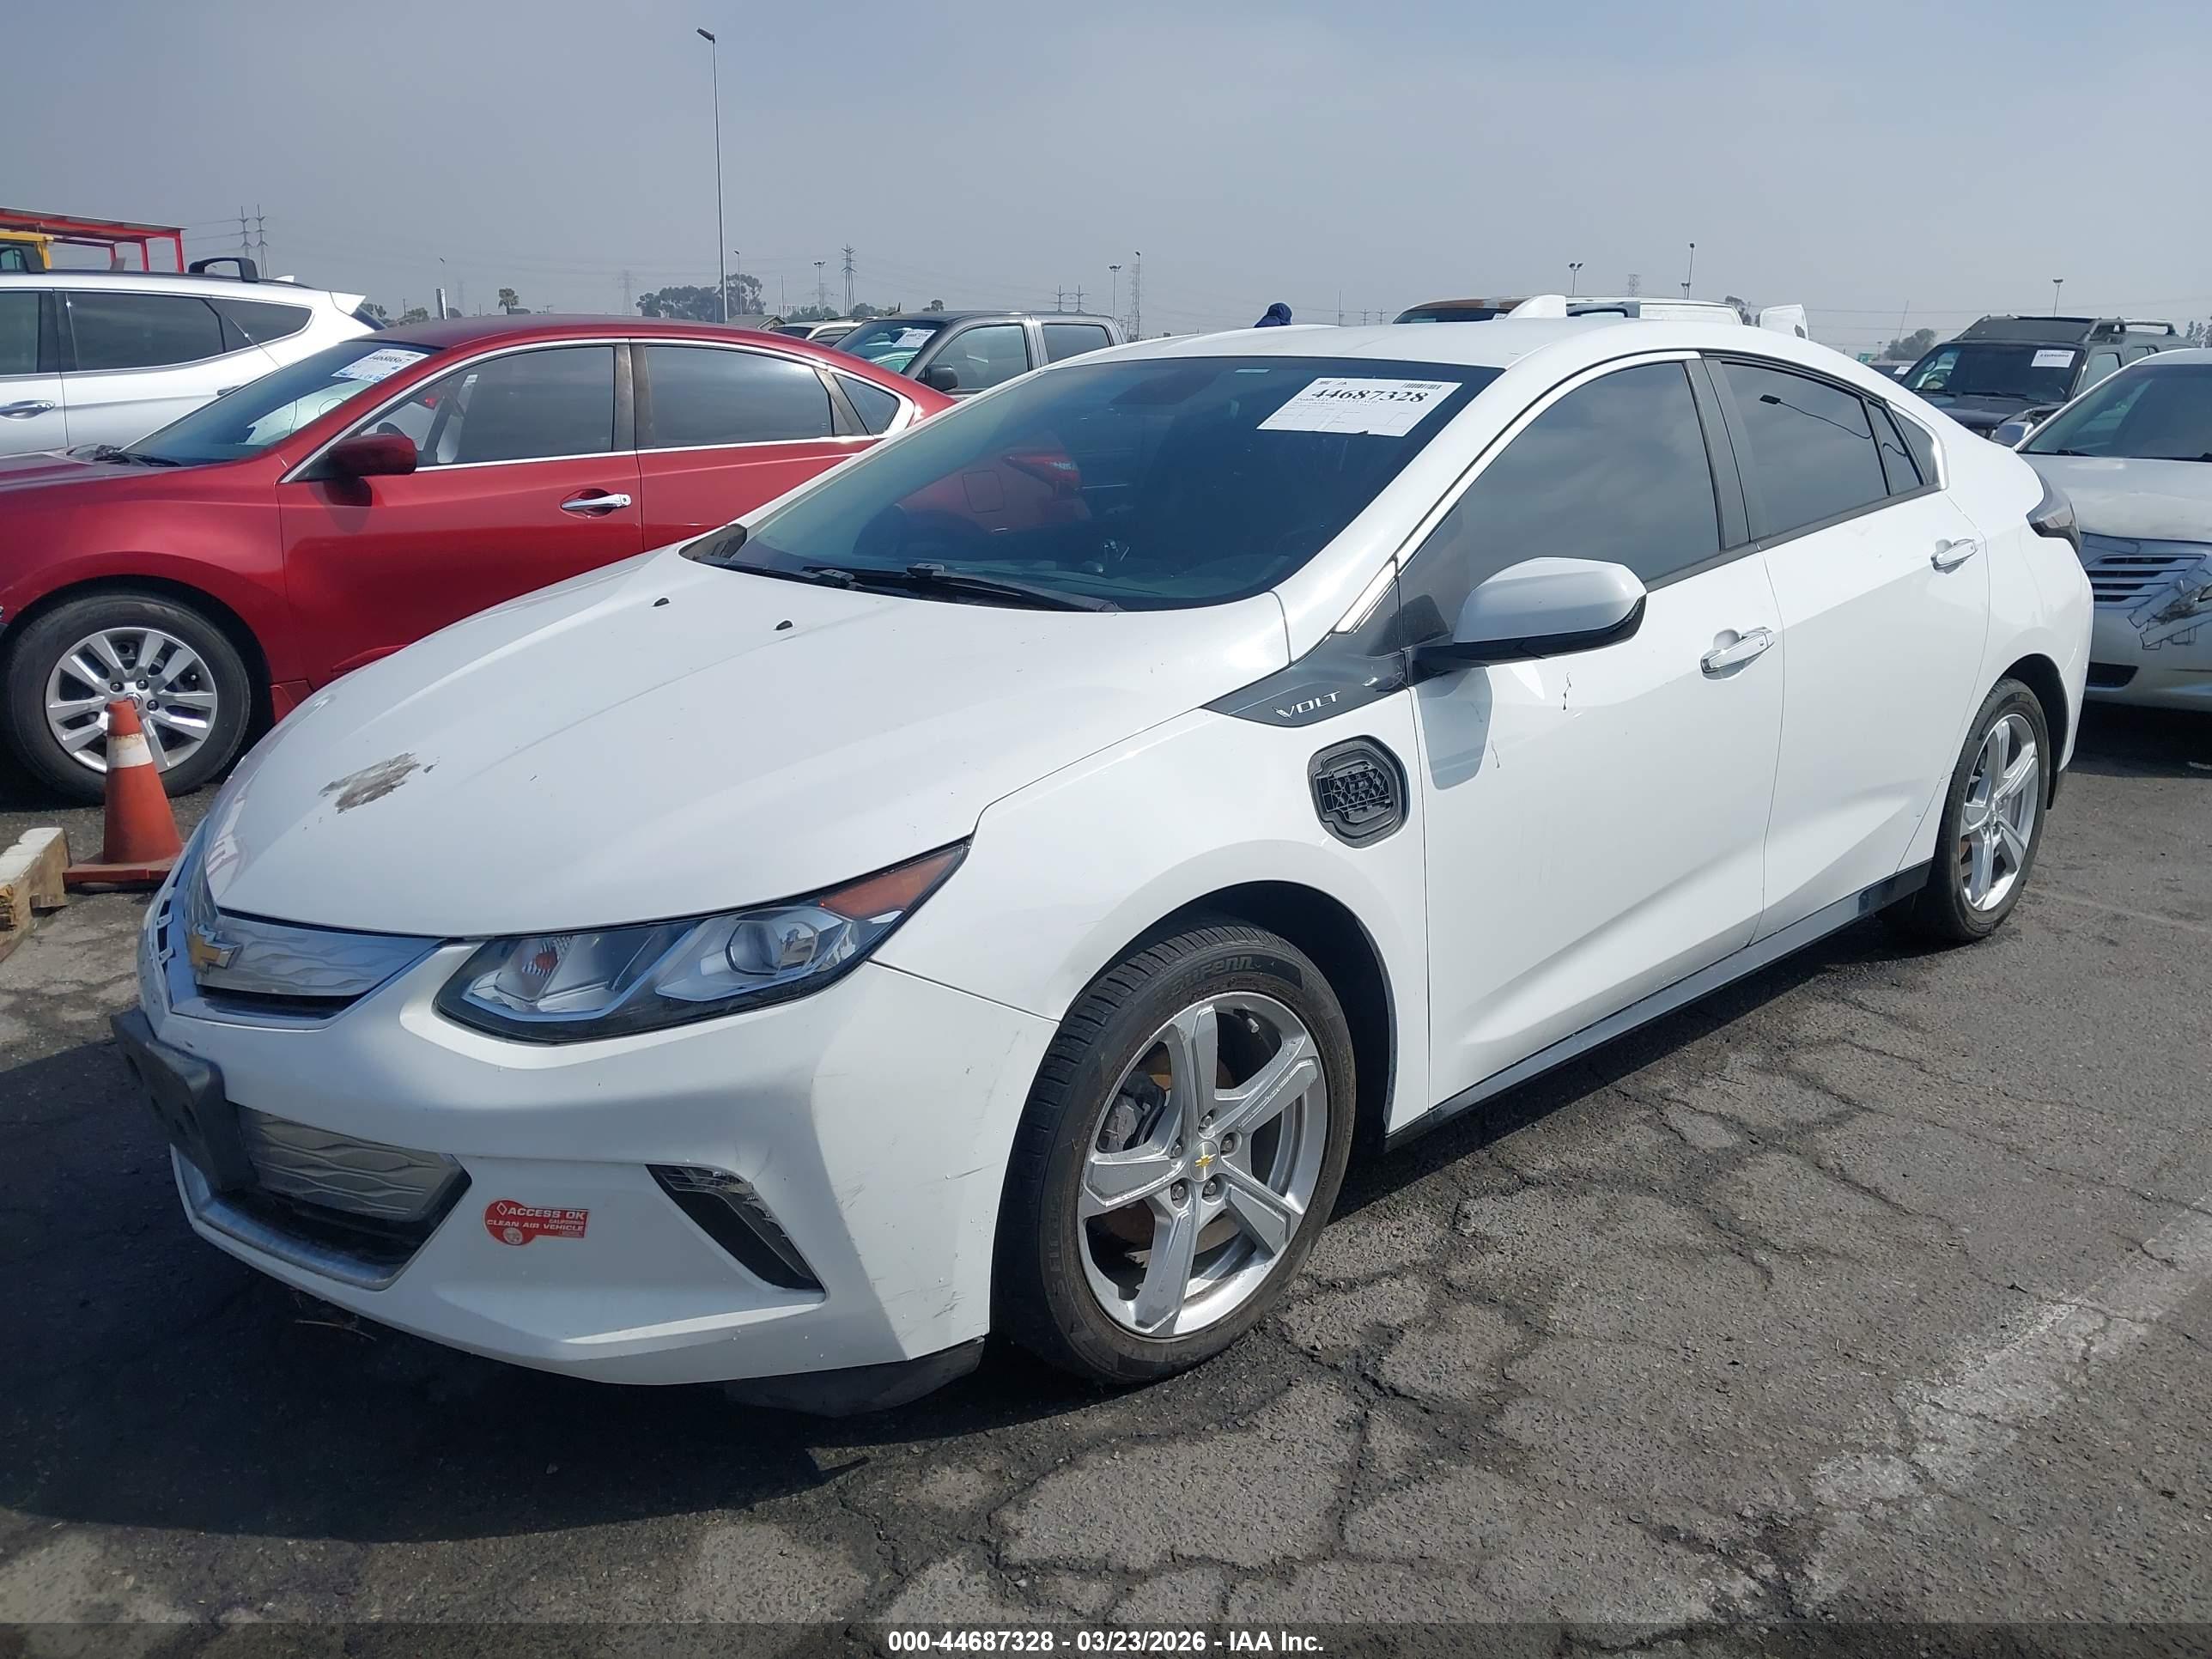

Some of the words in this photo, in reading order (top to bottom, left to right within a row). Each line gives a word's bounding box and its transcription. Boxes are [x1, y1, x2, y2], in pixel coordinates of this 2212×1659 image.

[1311, 388, 1429, 404] 44687328
[1272, 690, 1340, 719] VOLT
[507, 1207, 561, 1218] ACCESS
[566, 1212, 586, 1220] OK
[487, 1219, 520, 1228] CLEAN
